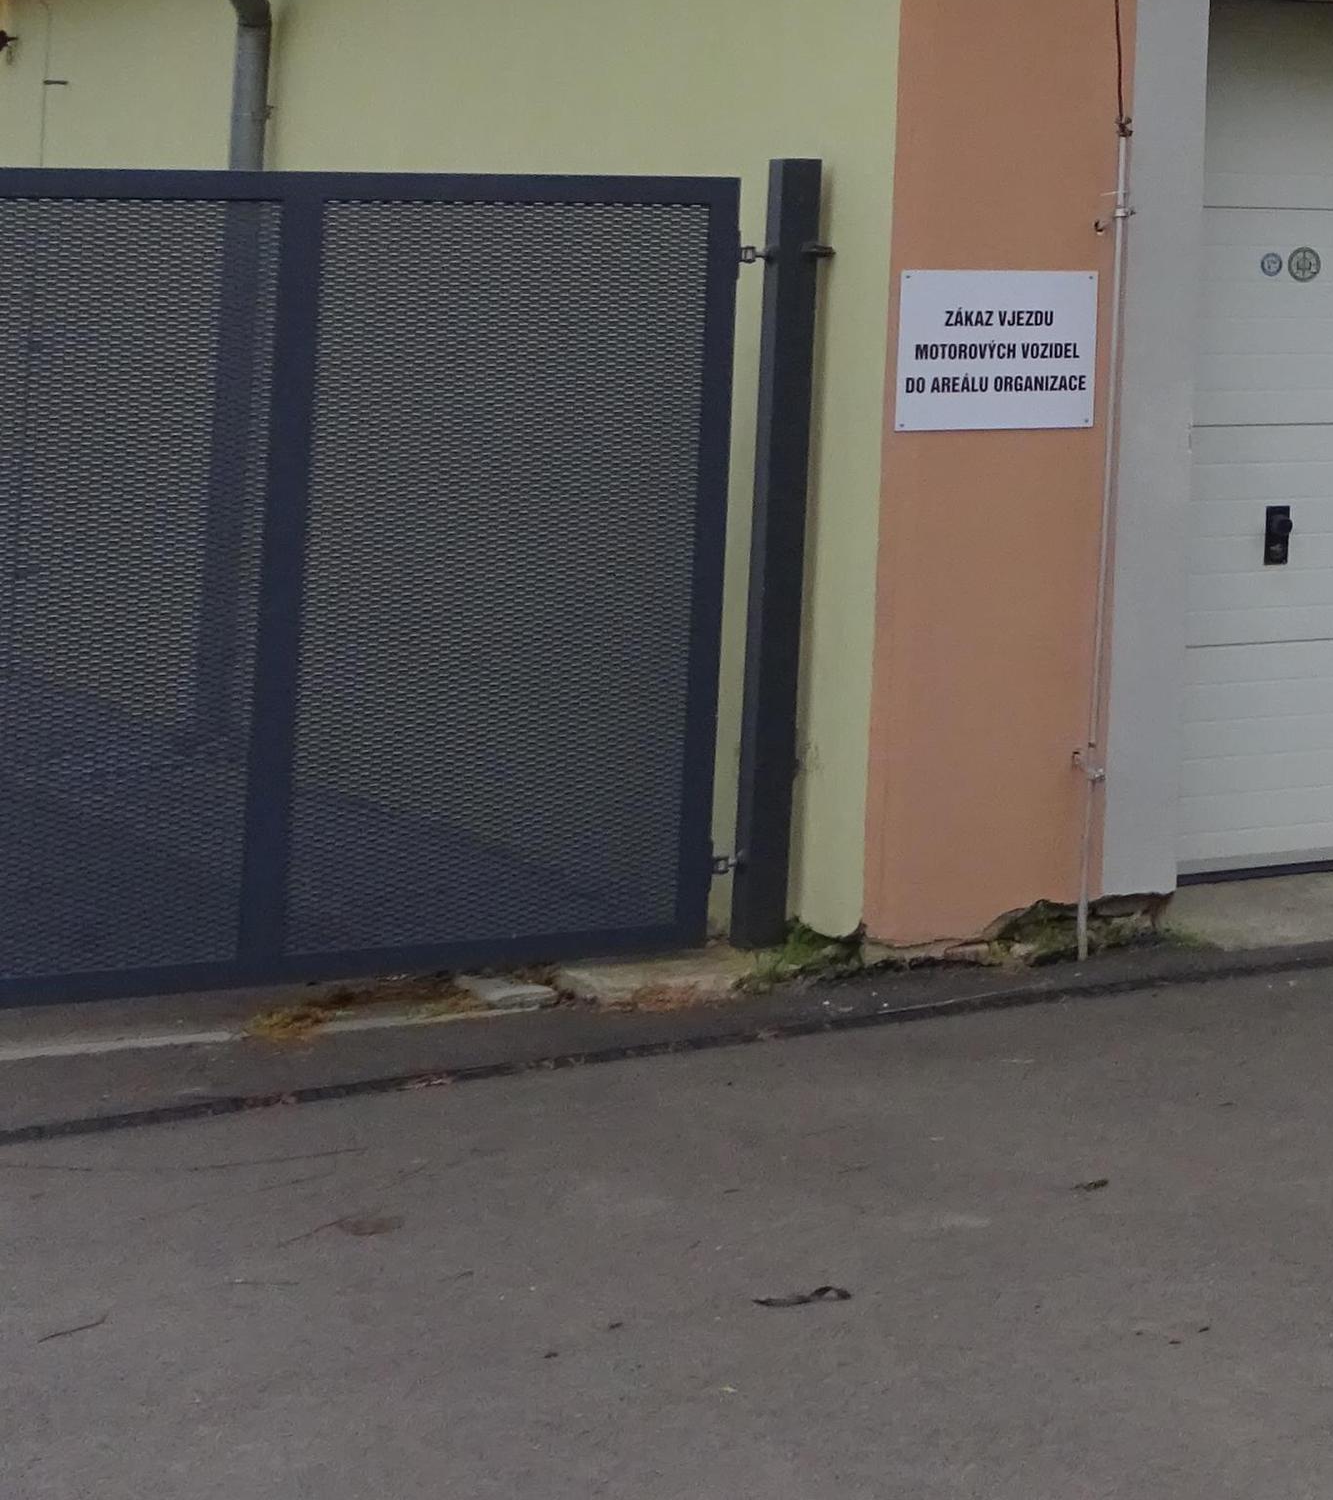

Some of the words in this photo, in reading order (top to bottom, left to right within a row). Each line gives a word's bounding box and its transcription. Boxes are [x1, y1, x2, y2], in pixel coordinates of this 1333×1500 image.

[944, 307, 994, 327] ZÁKAZ
[998, 310, 1055, 327] VJEZDU
[914, 340, 1017, 361] MOTOROVÝCH
[1021, 342, 1081, 360] VOZIDEL
[905, 376, 926, 394] DO
[930, 372, 989, 393] AREÁLU
[993, 374, 1087, 392] ORGANIZACE
